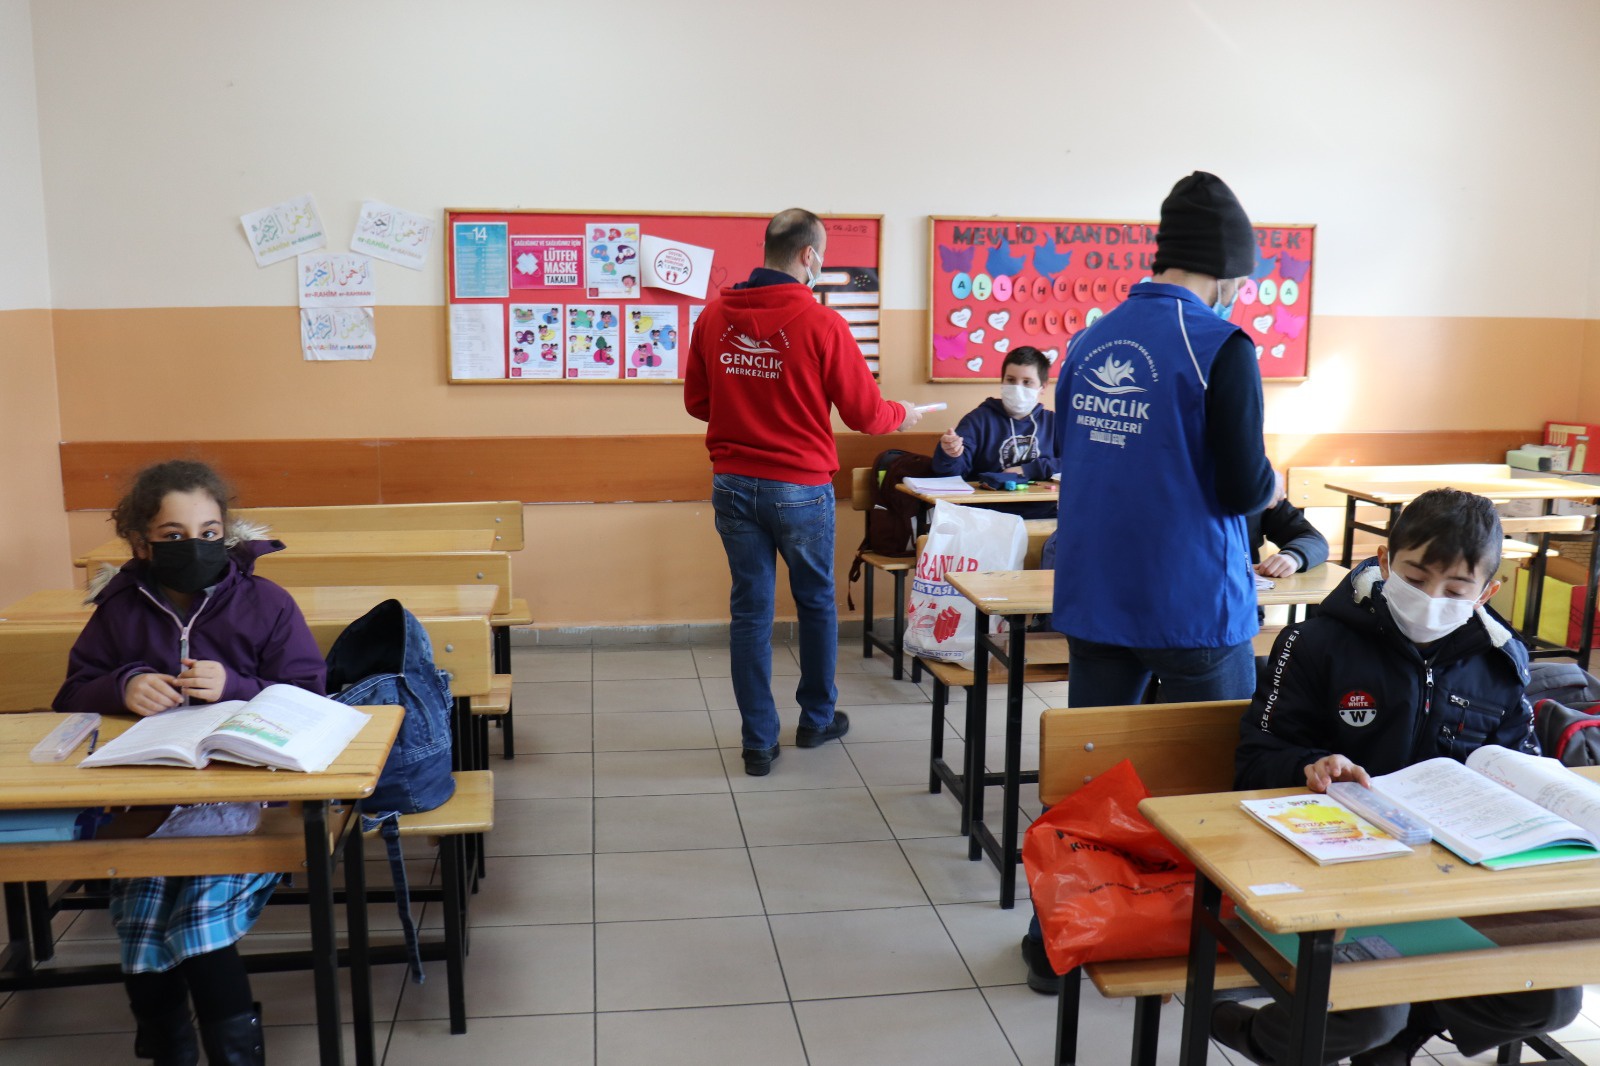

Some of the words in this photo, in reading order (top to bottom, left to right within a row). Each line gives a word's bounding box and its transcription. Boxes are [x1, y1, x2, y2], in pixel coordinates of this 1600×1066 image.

[472, 226, 488, 241] 14
[953, 225, 1037, 246] MEVLİD
[543, 247, 577, 261] LÜTFEN
[1085, 251, 1155, 270] OLSU
[543, 261, 577, 274] MASKE
[546, 275, 576, 284] TAKALIM
[719, 352, 783, 372] GENÇLİK
[725, 366, 780, 379] MERKEZLERİ
[1072, 393, 1151, 420] GENÇLİK
[1076, 414, 1142, 435] MERKEZLERİ
[912, 581, 960, 595] KIRTASİY
[1349, 710, 1367, 723] W
